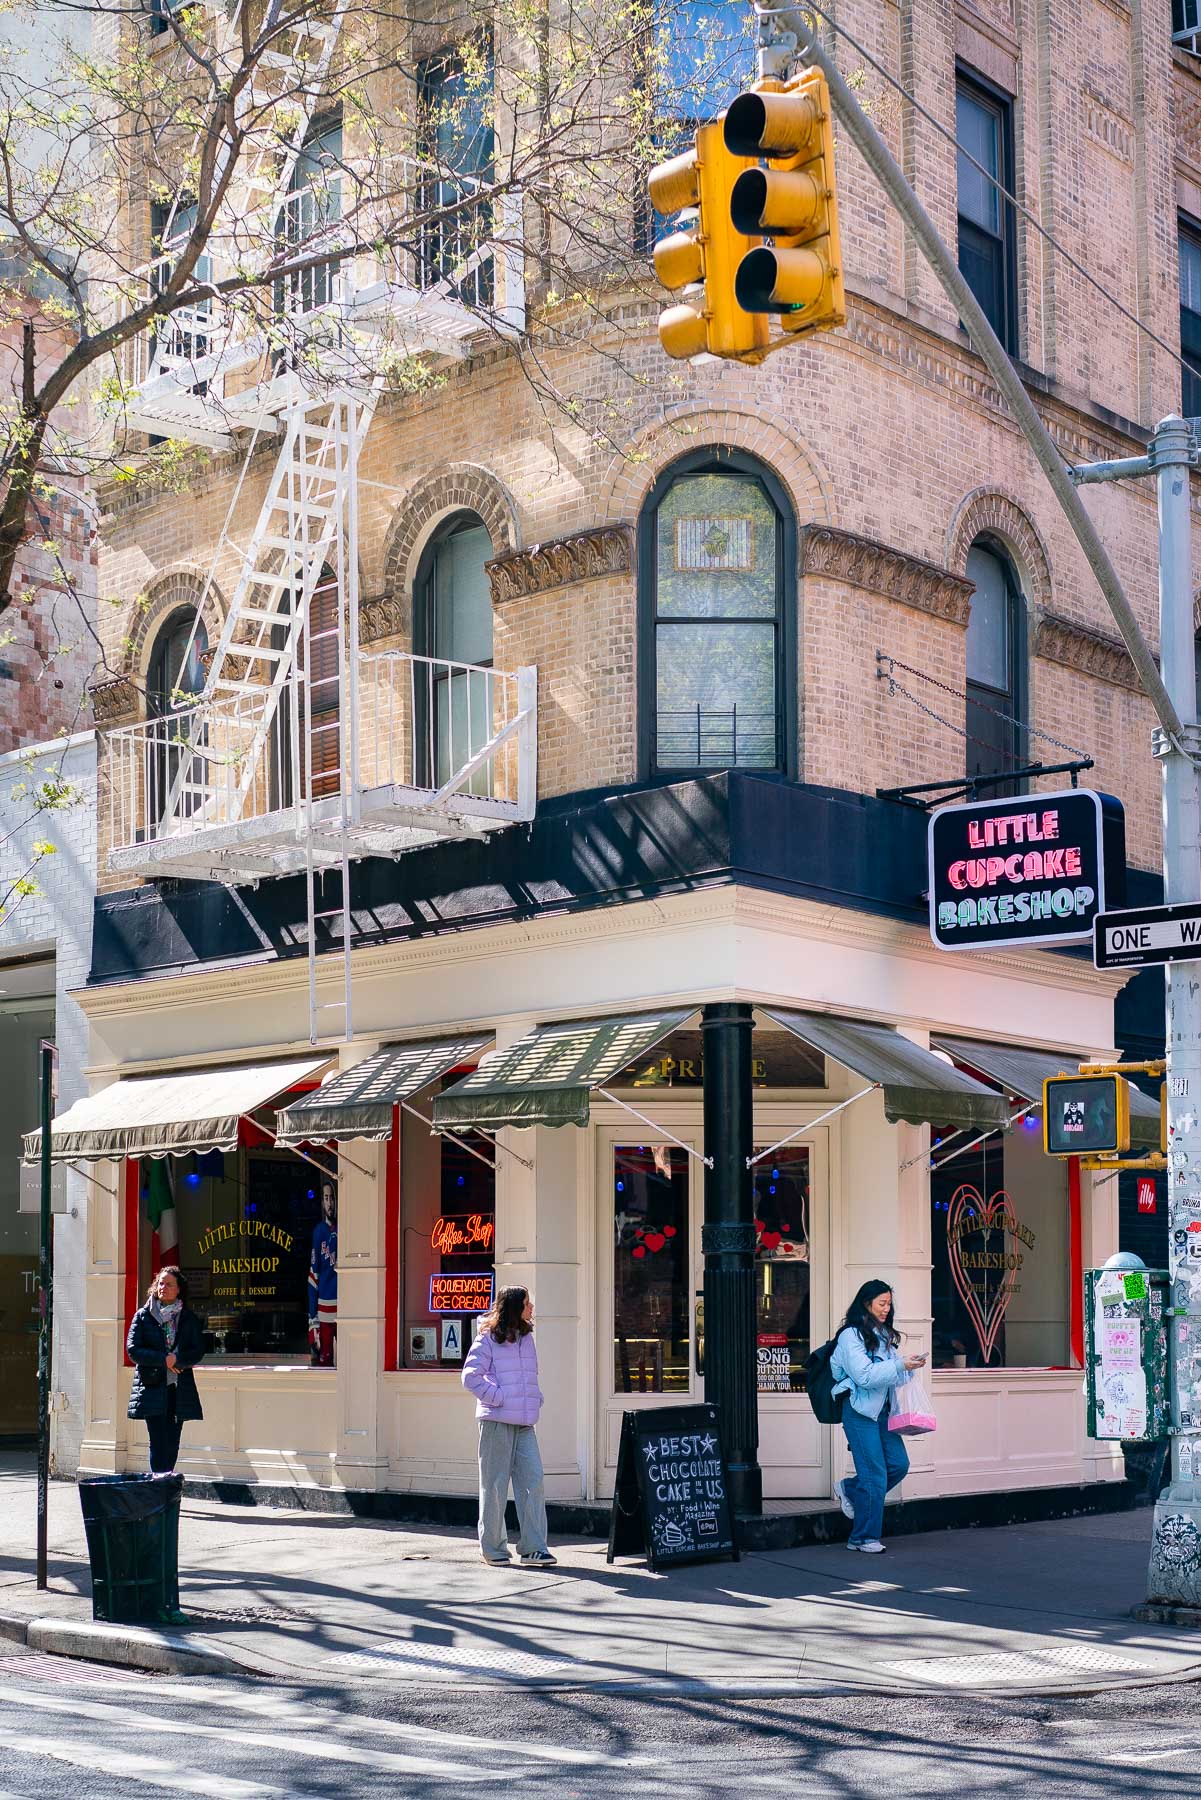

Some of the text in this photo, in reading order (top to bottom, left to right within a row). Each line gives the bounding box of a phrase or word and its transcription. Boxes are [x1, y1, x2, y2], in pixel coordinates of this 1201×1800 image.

[968, 810, 1060, 849] LITTLE
[948, 847, 1082, 890] CUPCAKE
[938, 886, 1095, 930] BAKESHOP
[1112, 927, 1151, 950] ONE
[1140, 1184, 1154, 1210] illy
[198, 1220, 294, 1254] LITTLE CUPCAKE
[432, 1215, 493, 1254] Coffee Shop
[212, 1257, 280, 1274] BAKESHOP
[961, 1251, 1024, 1270] BAKESHOP
[214, 1287, 237, 1296] COFFEE
[249, 1286, 276, 1295] DESSERT
[432, 1279, 492, 1293] HOMEMADE
[433, 1295, 490, 1309] ICE CREAM
[445, 1325, 458, 1347] A
[772, 1354, 790, 1364] NO
[660, 1435, 701, 1457] BEST
[648, 1460, 722, 1482] CHOCOLATE
[656, 1481, 691, 1502] CAKE
[680, 1502, 698, 1513] Food
[704, 1501, 721, 1511] Wine
[685, 1510, 716, 1520] Magazine
[656, 1547, 674, 1555] LITTLE
